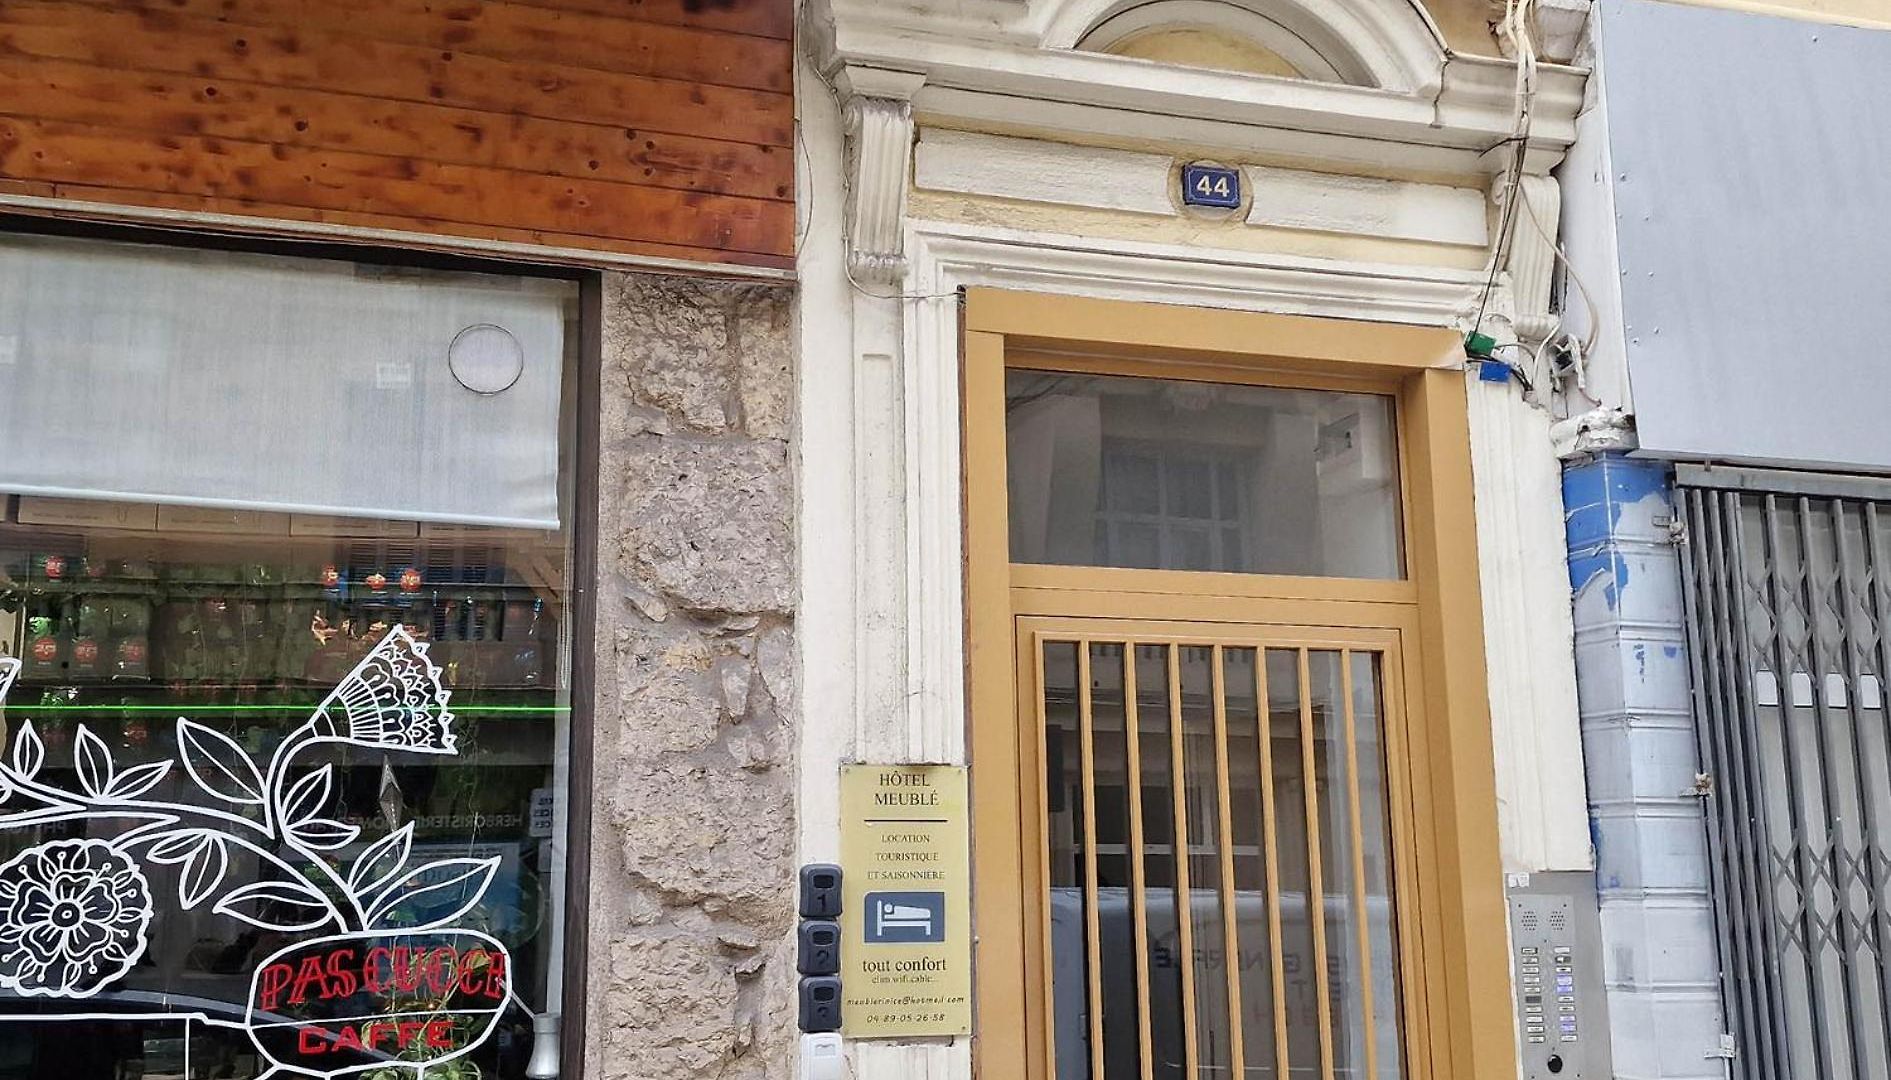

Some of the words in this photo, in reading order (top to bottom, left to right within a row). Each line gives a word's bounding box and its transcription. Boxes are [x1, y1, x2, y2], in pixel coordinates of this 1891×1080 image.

[1196, 175, 1230, 198] 44
[880, 770, 931, 787] HÔTEL
[874, 789, 940, 806] MEUBLÉ
[881, 834, 931, 843] LOCATION
[875, 852, 940, 862] TOURISTIQUE
[867, 871, 881, 880] ET
[817, 893, 827, 913] 1
[862, 960, 891, 972] tout
[895, 956, 947, 972] confort
[259, 944, 507, 1011] PASCUCCI
[298, 1021, 455, 1055] CAFFE
